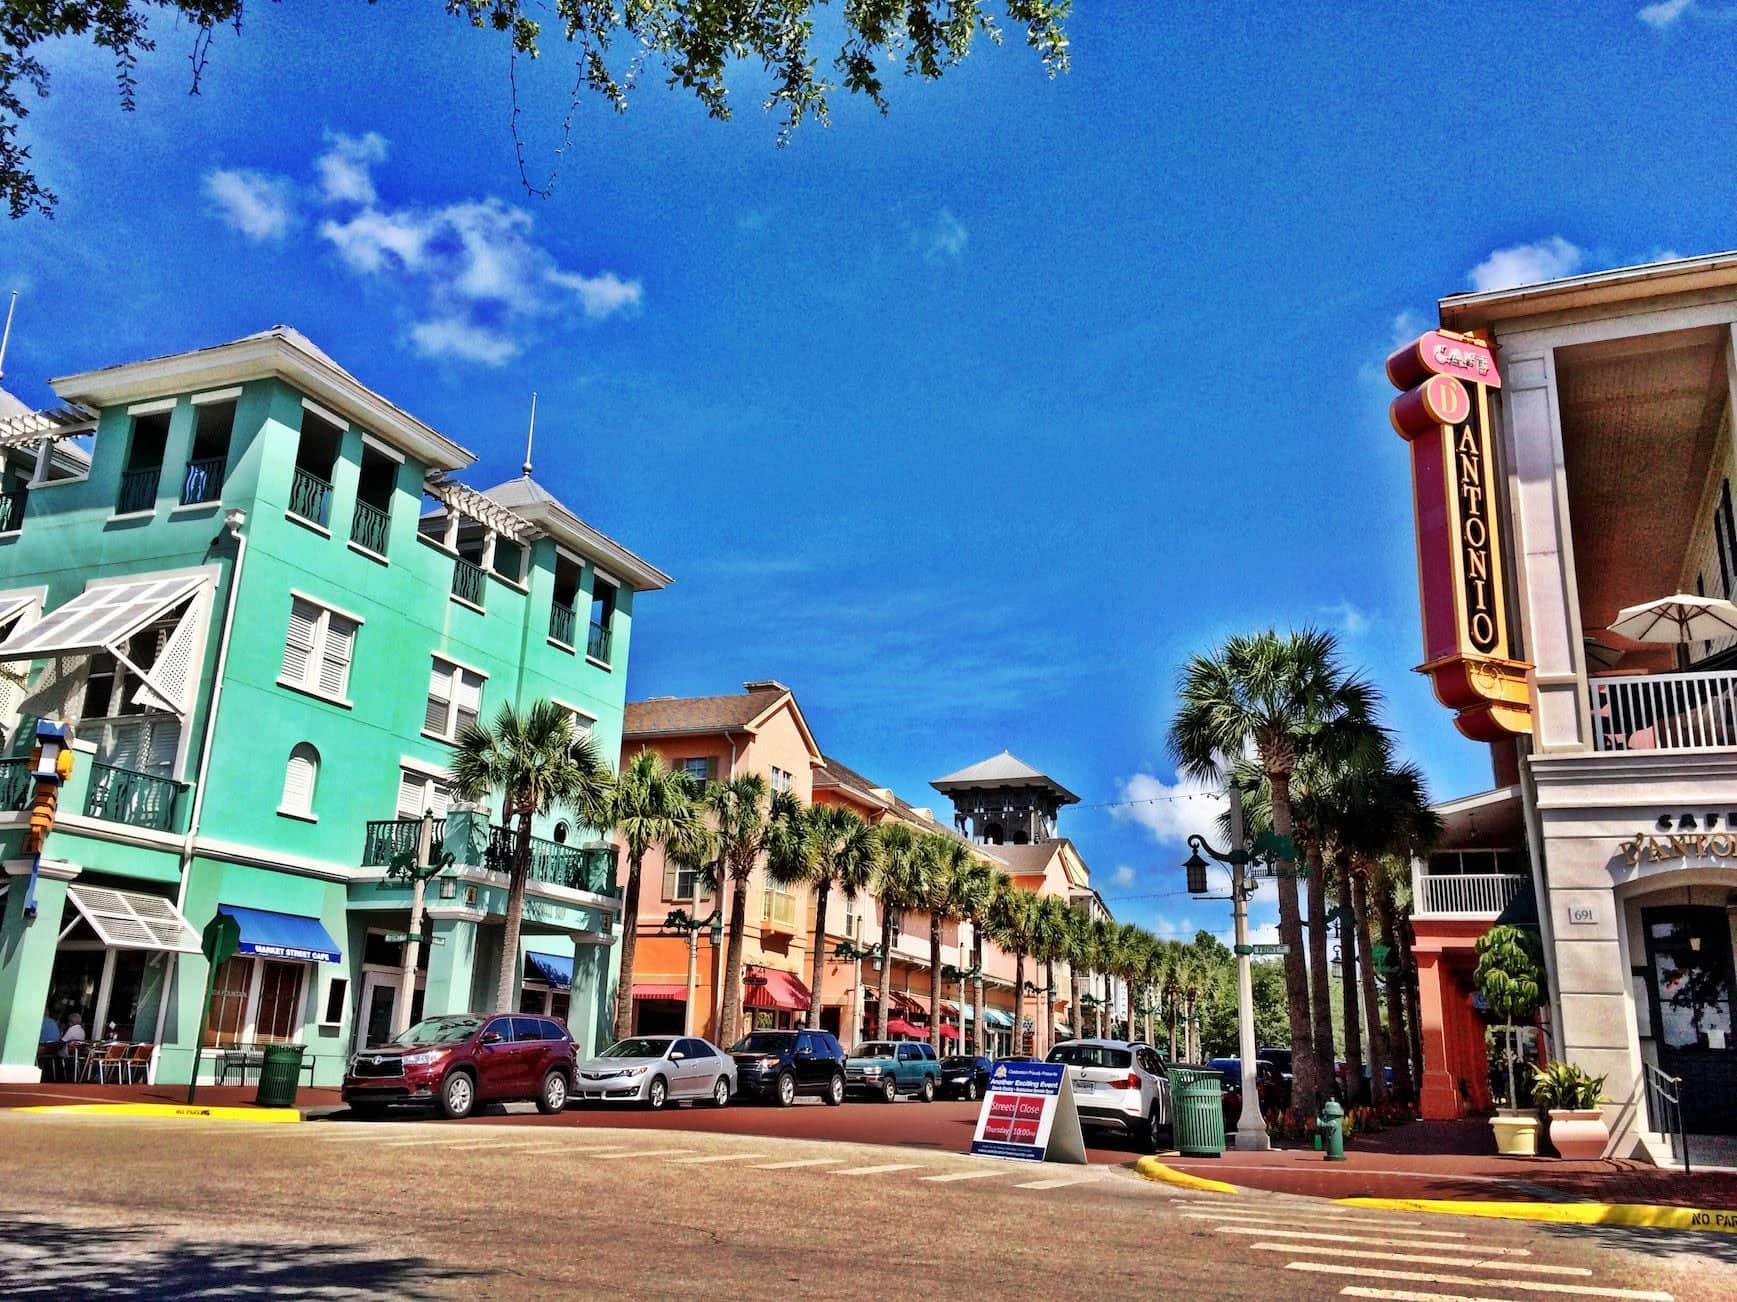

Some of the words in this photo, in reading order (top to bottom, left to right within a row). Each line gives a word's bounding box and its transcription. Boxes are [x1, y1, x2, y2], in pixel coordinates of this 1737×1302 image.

[1574, 908, 1593, 921] 691
[255, 944, 285, 956] MARKET
[285, 948, 312, 958] STREET
[1015, 1080, 1039, 1088] Exciting
[1040, 1081, 1058, 1089] Event
[991, 1102, 1017, 1112] Streets
[1020, 1104, 1040, 1114] Close
[1692, 1213, 1710, 1225] NO
